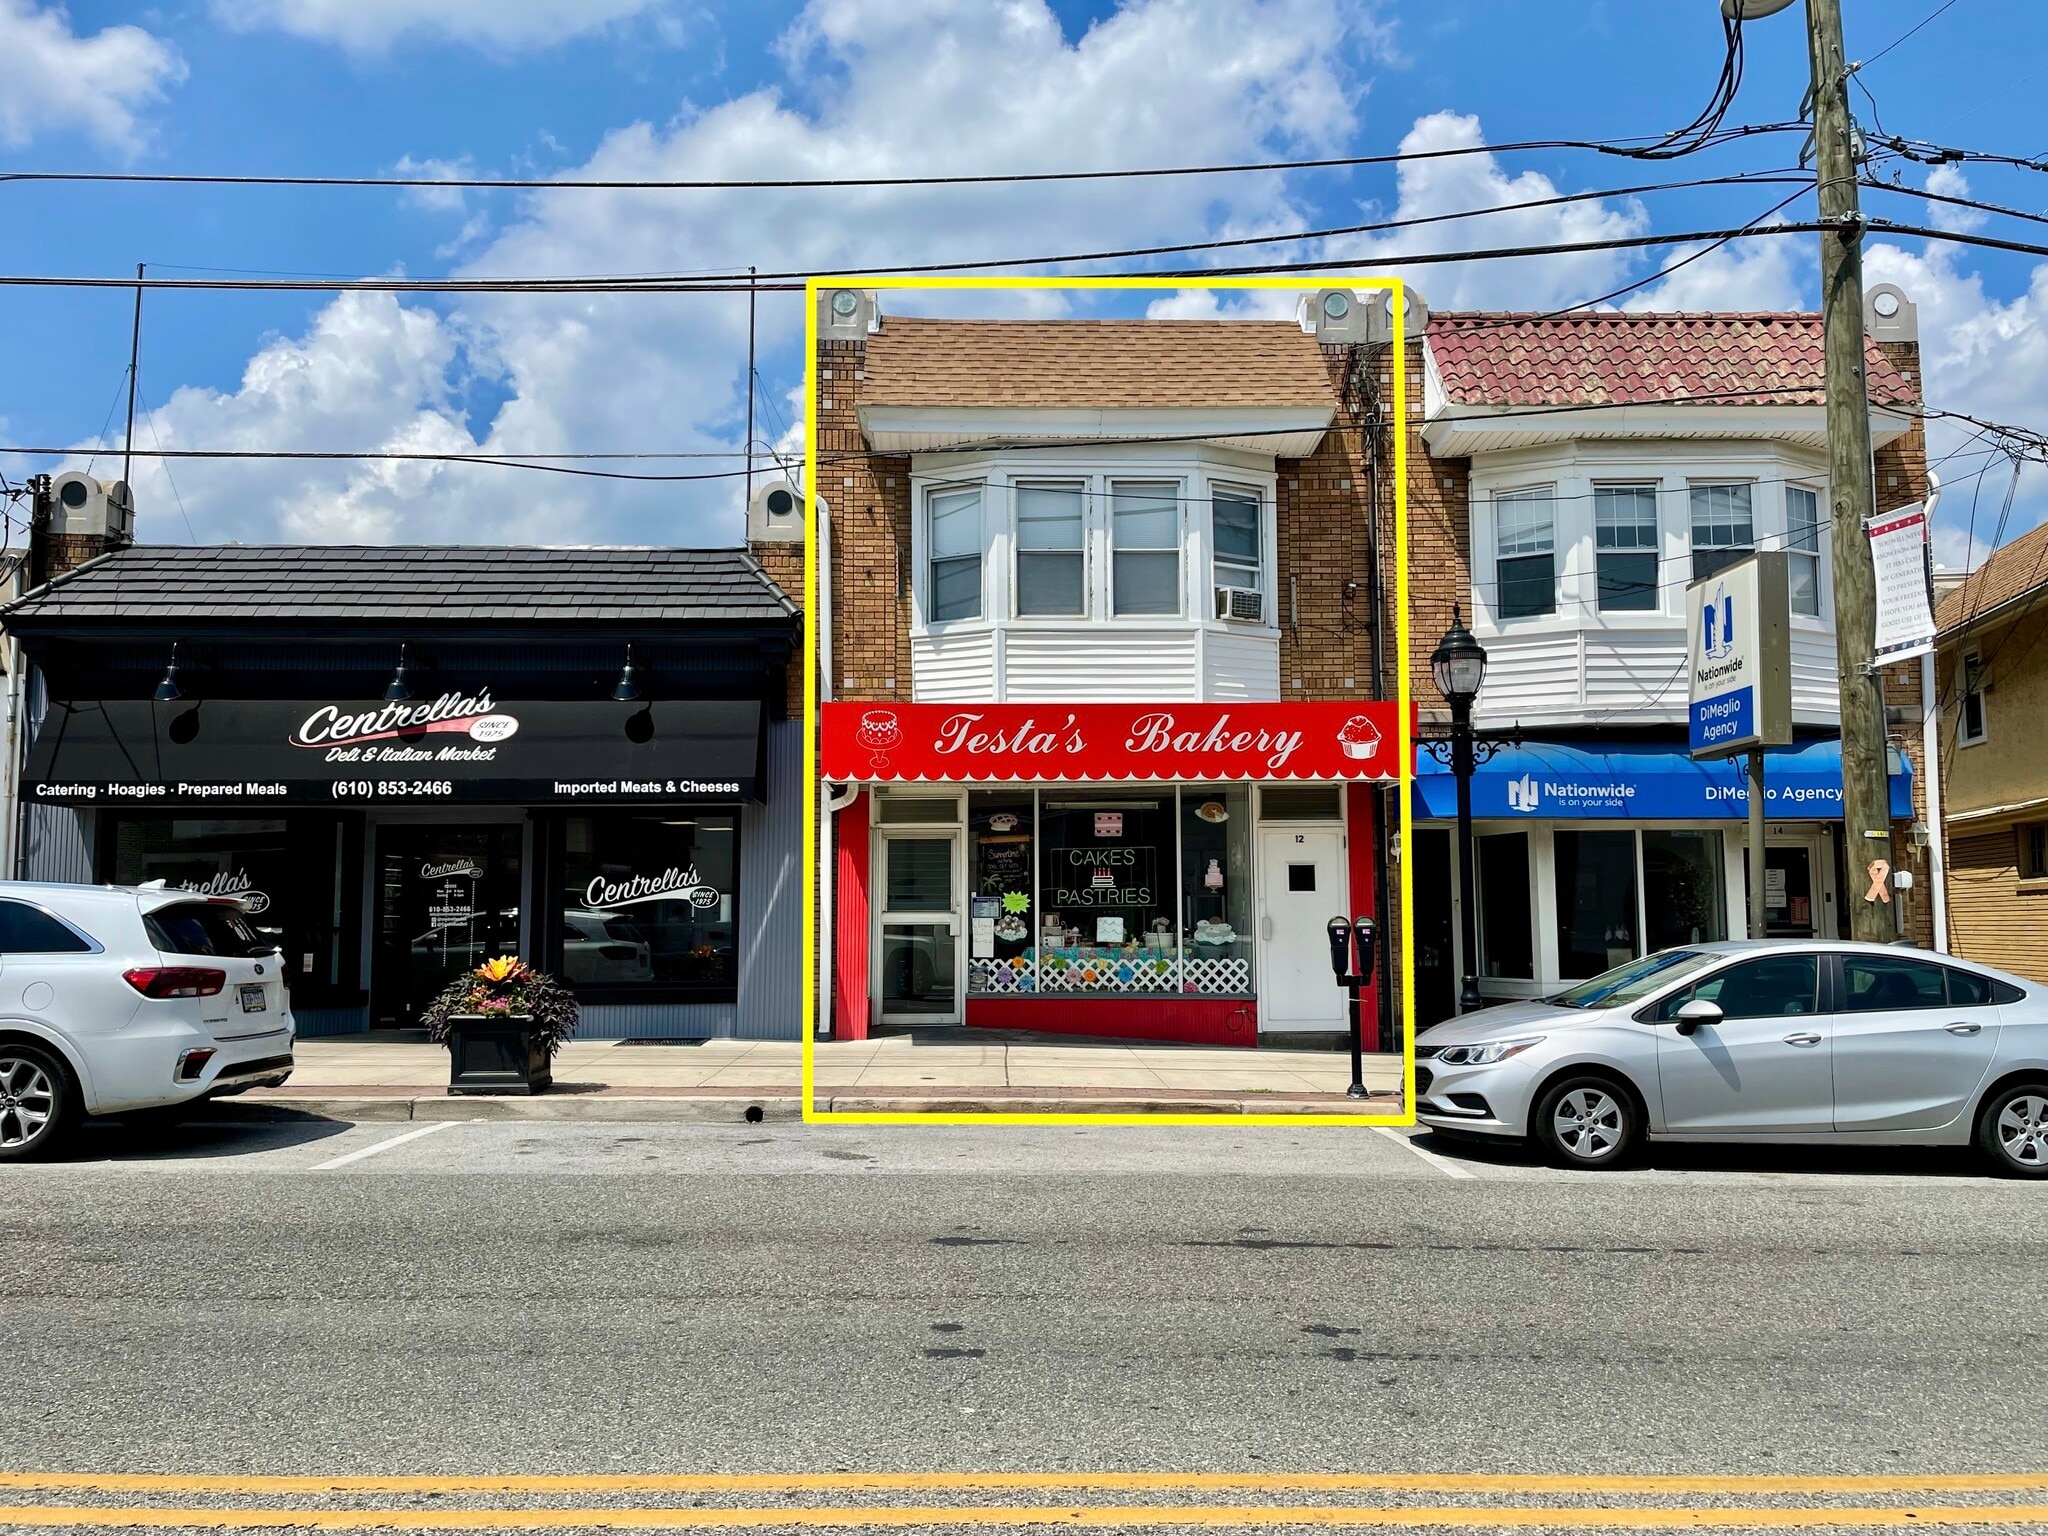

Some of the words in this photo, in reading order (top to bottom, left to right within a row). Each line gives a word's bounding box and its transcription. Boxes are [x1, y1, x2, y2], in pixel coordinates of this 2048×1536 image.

[1894, 546, 1909, 555] HOW
[1893, 559, 1905, 567] HAS
[1905, 554, 1921, 564] COST
[1890, 567, 1924, 580] GENERATIO
[1882, 595, 1899, 605] YOUR
[1900, 590, 1926, 601] FREEDO
[1884, 606, 1901, 616] HOPE
[1901, 603, 1915, 612] YOU
[1881, 618, 1900, 628] GOOD
[1901, 615, 1913, 624] USE
[1913, 613, 1922, 621] OF
[1697, 658, 1743, 683] Nationwide
[1716, 679, 1726, 689] your
[1726, 675, 1736, 684] side
[299, 686, 496, 743] Centrella's
[1700, 698, 1740, 721] DiMeglio
[1703, 721, 1738, 740] Agency
[934, 713, 1088, 754] Testa's
[1124, 712, 1304, 769] Bakery
[325, 747, 359, 763] Deli
[362, 748, 376, 762] &
[376, 747, 433, 762] Italian
[435, 745, 497, 762] Market
[36, 783, 96, 798] Catering
[108, 783, 166, 797] Hoagies
[178, 783, 242, 797] Prepared
[247, 782, 287, 795] Meals
[332, 780, 373, 798] (610)
[378, 781, 452, 795] 853-2466
[554, 781, 617, 796] Imported
[620, 781, 662, 793] Meats
[665, 781, 676, 793] &
[680, 780, 740, 793] Cheeses
[1544, 783, 1635, 797] Nationwide
[1705, 786, 1777, 801] DiMeio
[1782, 786, 1843, 801] Agency
[1559, 798, 1566, 806] is
[1582, 798, 1602, 808] your
[1604, 798, 1623, 807] side
[1295, 835, 1304, 843] 12
[1773, 827, 1783, 835] 14
[1069, 849, 1135, 865] CAKES
[421, 857, 475, 877] Centrella's
[586, 863, 701, 905] Centrella's
[1057, 887, 1151, 905] PASTRIES
